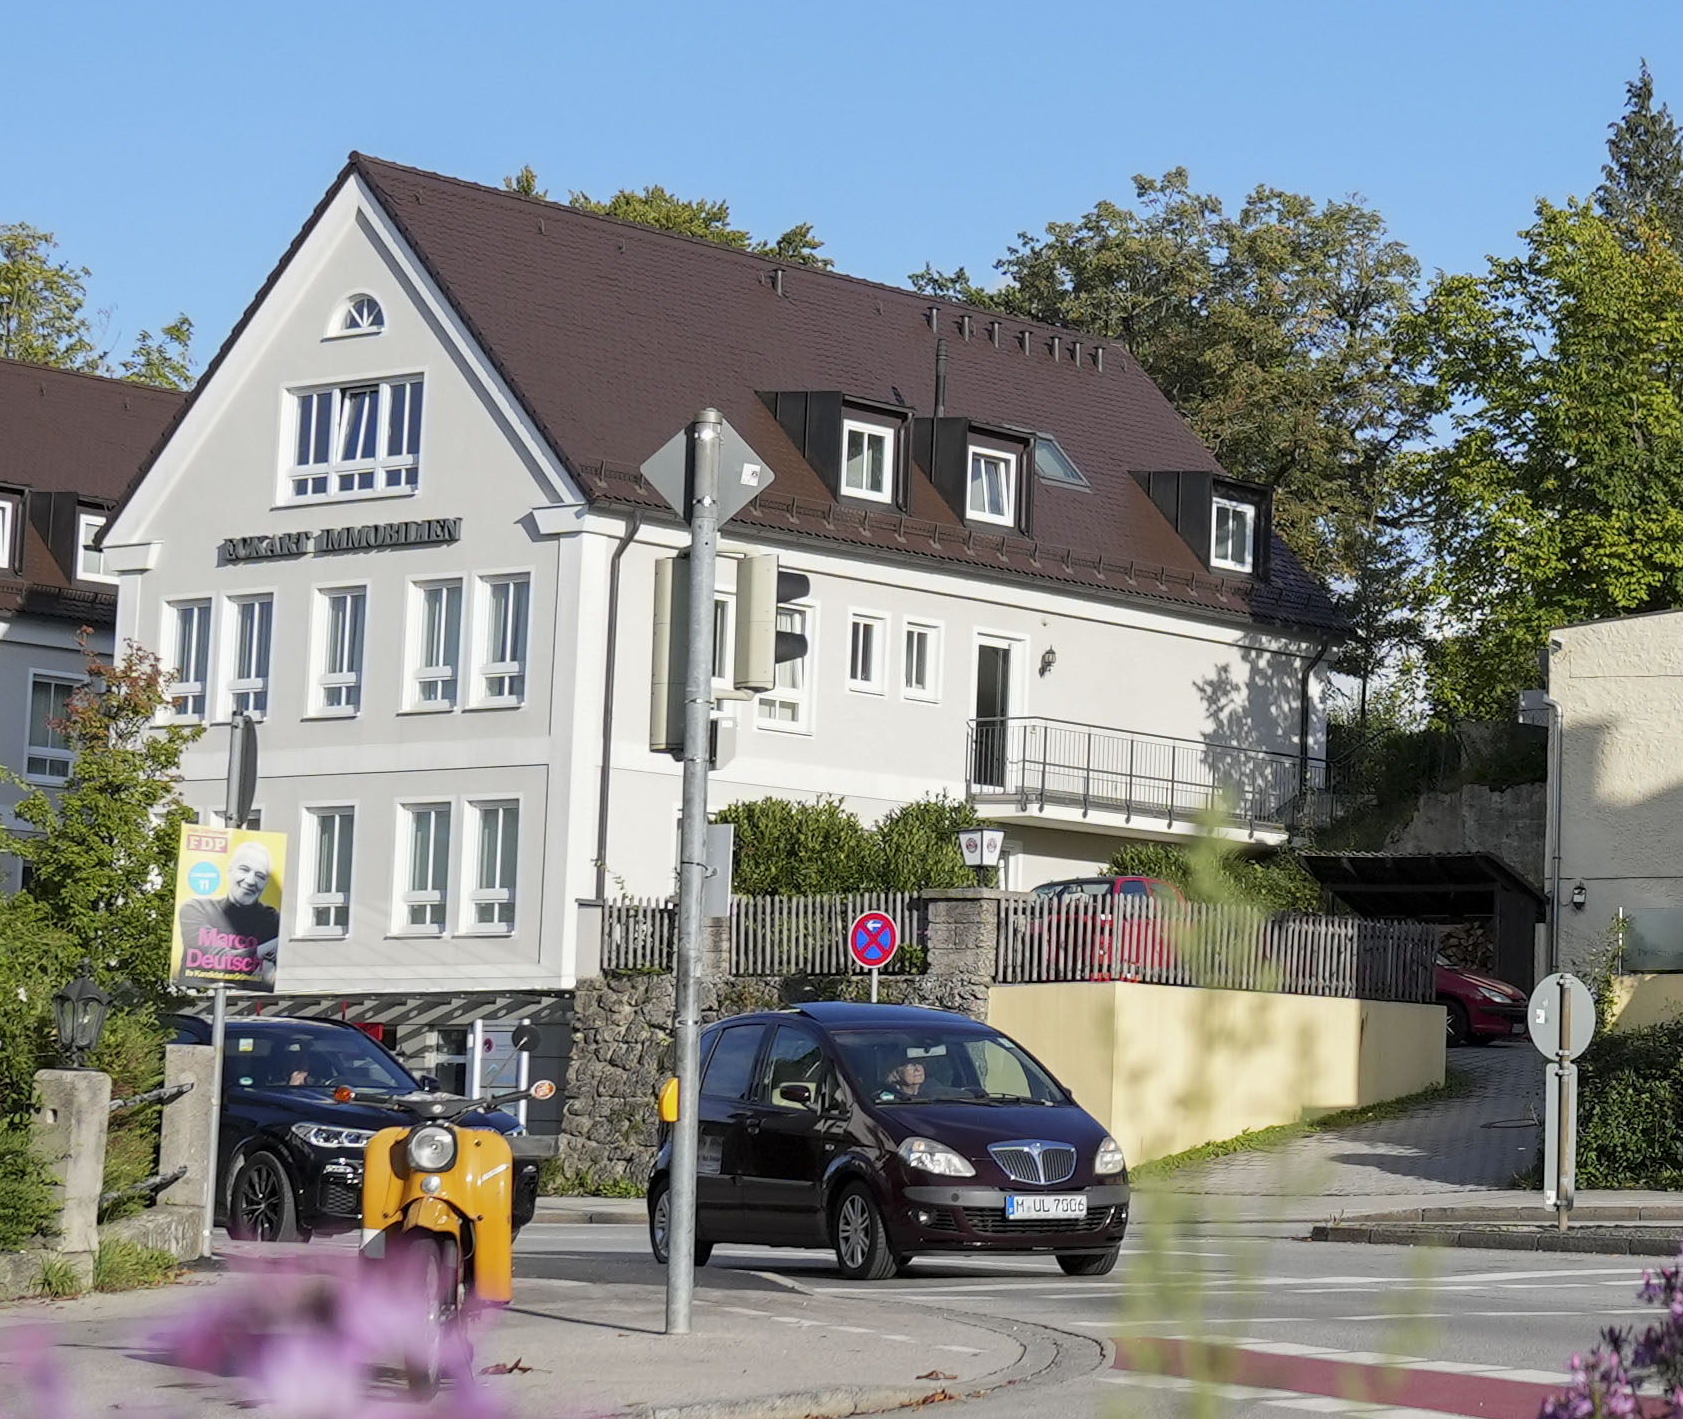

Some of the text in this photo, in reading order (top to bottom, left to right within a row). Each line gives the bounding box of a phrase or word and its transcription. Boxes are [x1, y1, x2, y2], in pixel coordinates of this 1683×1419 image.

[218, 517, 463, 562] ECKART IMMOBILIEN
[187, 835, 227, 853] FDP
[197, 926, 259, 950] Marco
[185, 947, 265, 973] Deutsch
[1016, 1198, 1025, 1213] M
[1033, 1198, 1051, 1213] UL
